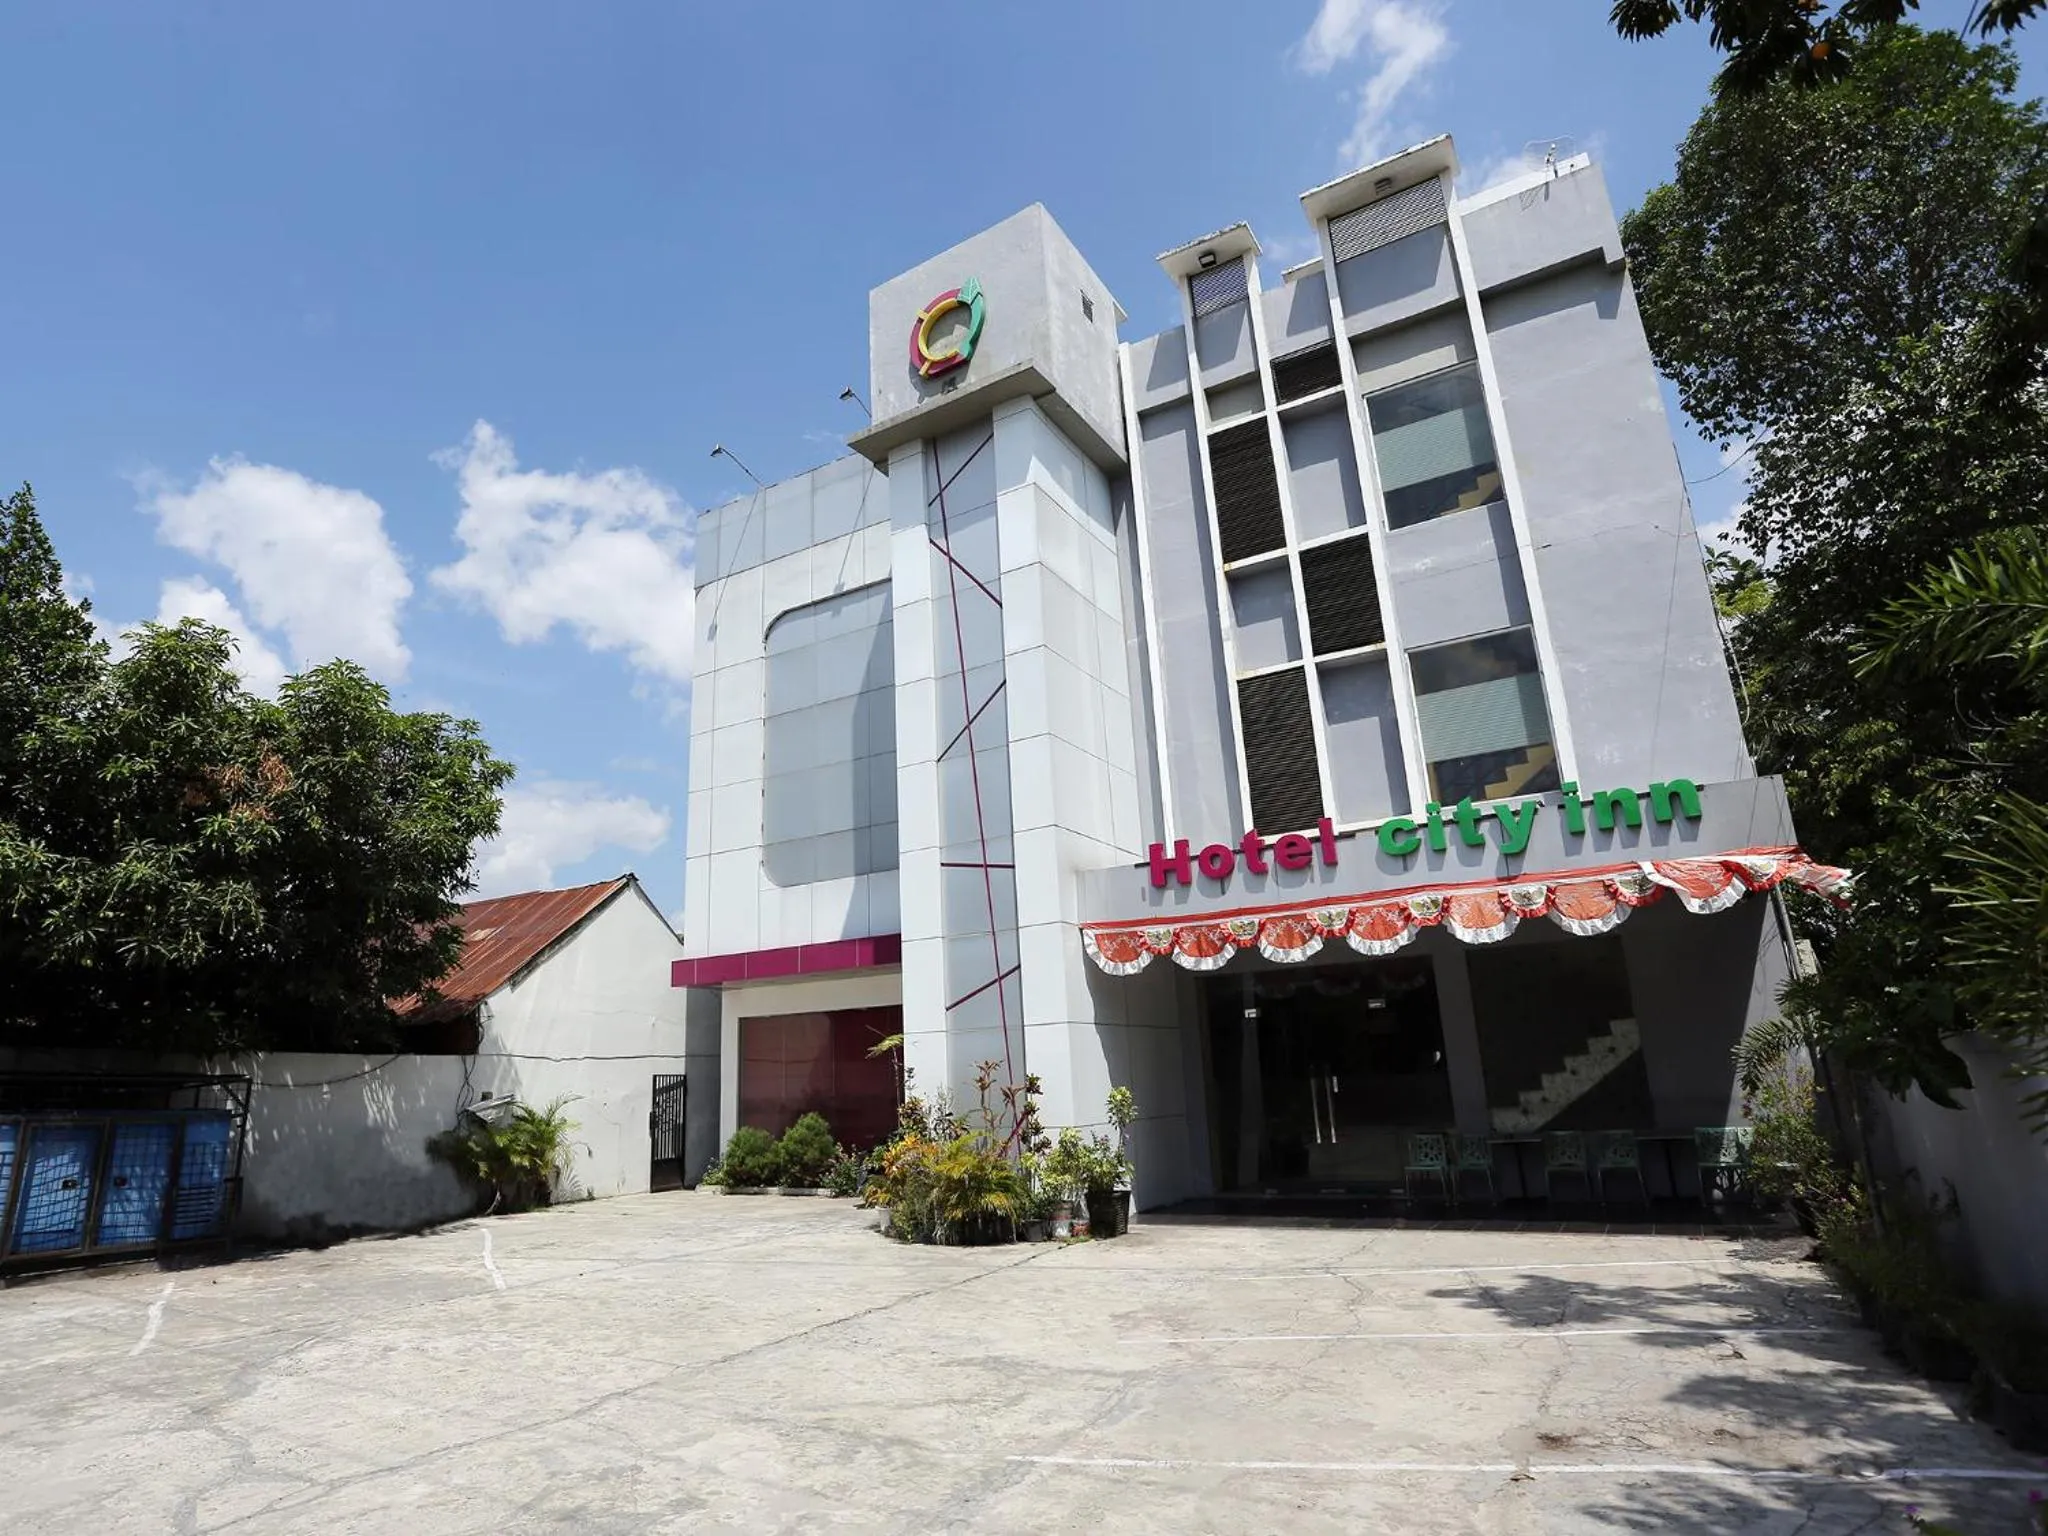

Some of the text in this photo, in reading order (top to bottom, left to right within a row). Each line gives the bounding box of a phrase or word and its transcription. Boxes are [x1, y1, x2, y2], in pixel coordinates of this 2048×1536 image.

[1148, 779, 1703, 889] Hotel city inn
